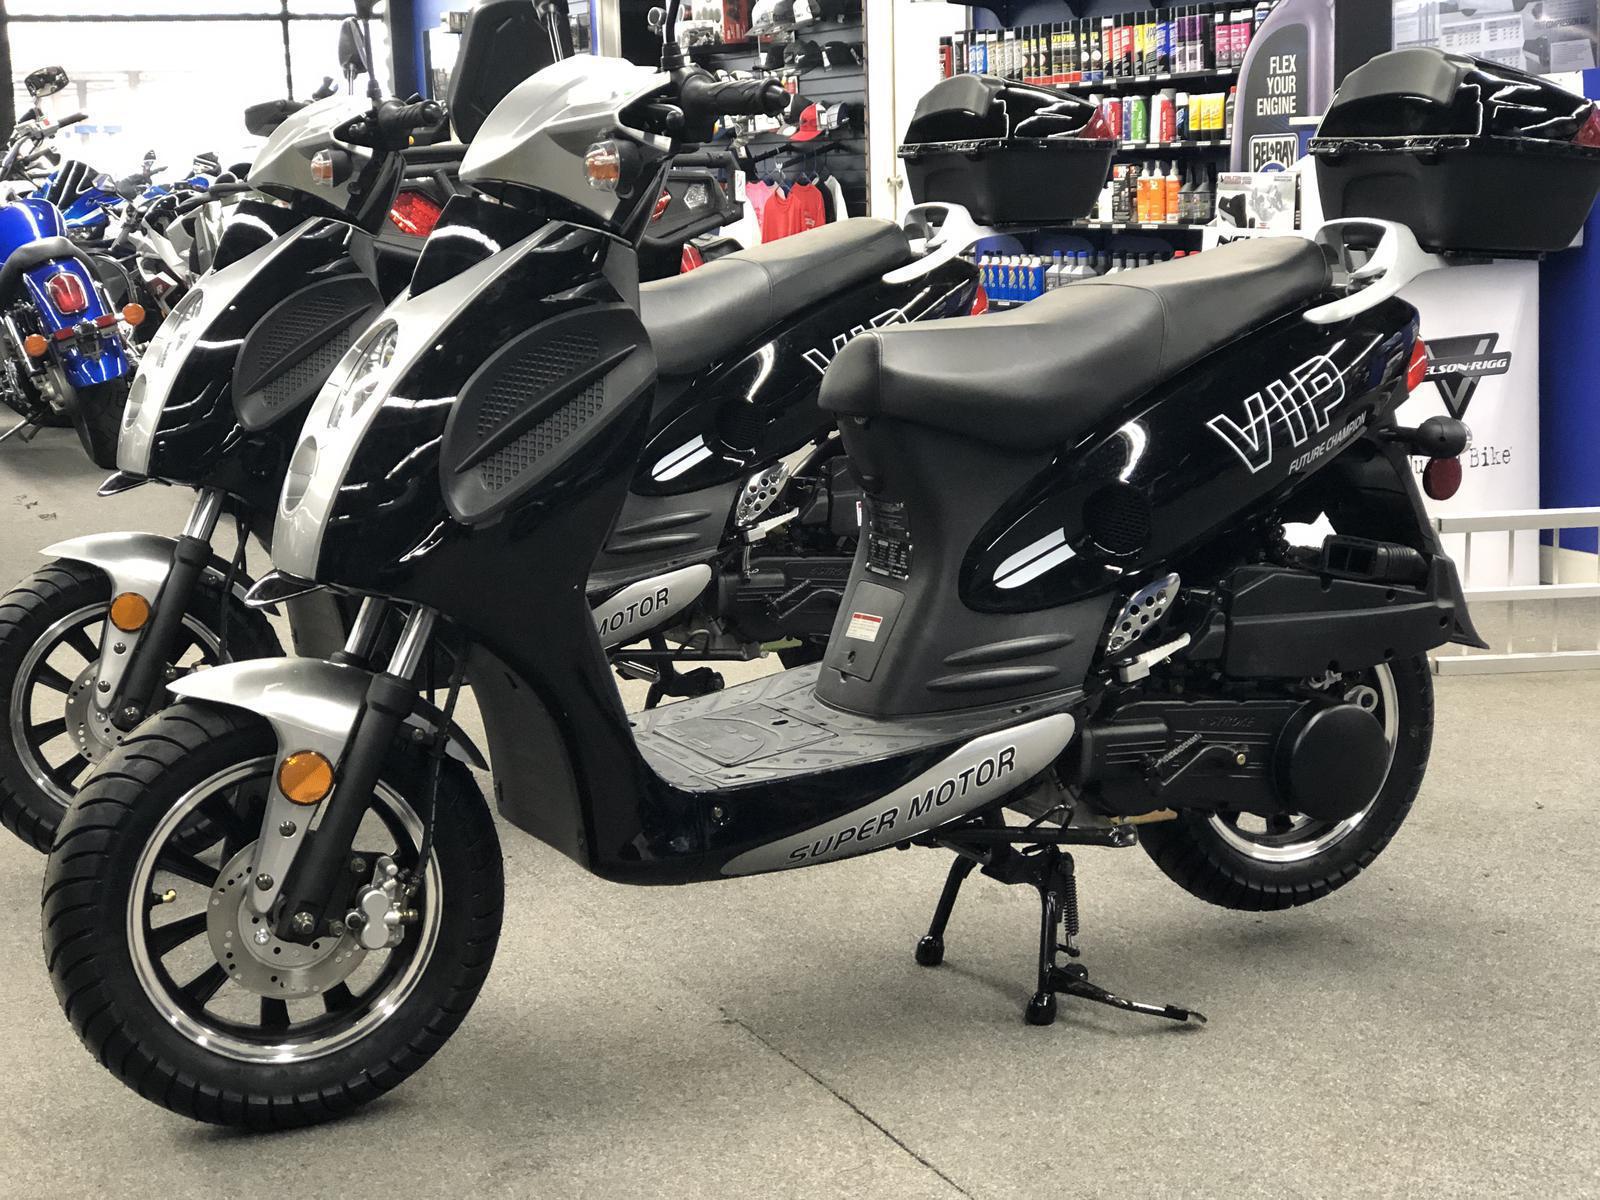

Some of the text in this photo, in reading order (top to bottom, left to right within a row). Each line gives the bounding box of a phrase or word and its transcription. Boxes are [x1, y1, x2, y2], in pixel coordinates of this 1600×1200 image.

[1269, 54, 1297, 75] FLEX
[1267, 75, 1297, 95] YOUR
[1256, 96, 1297, 116] ENGINE
[1425, 358, 1508, 376] ELSON-RIGG
[1206, 355, 1346, 474] VIP
[1288, 410, 1368, 476] FUTURE CHAMPION
[1469, 446, 1511, 468] Bike
[789, 744, 1017, 861] SUPER MOTOR
